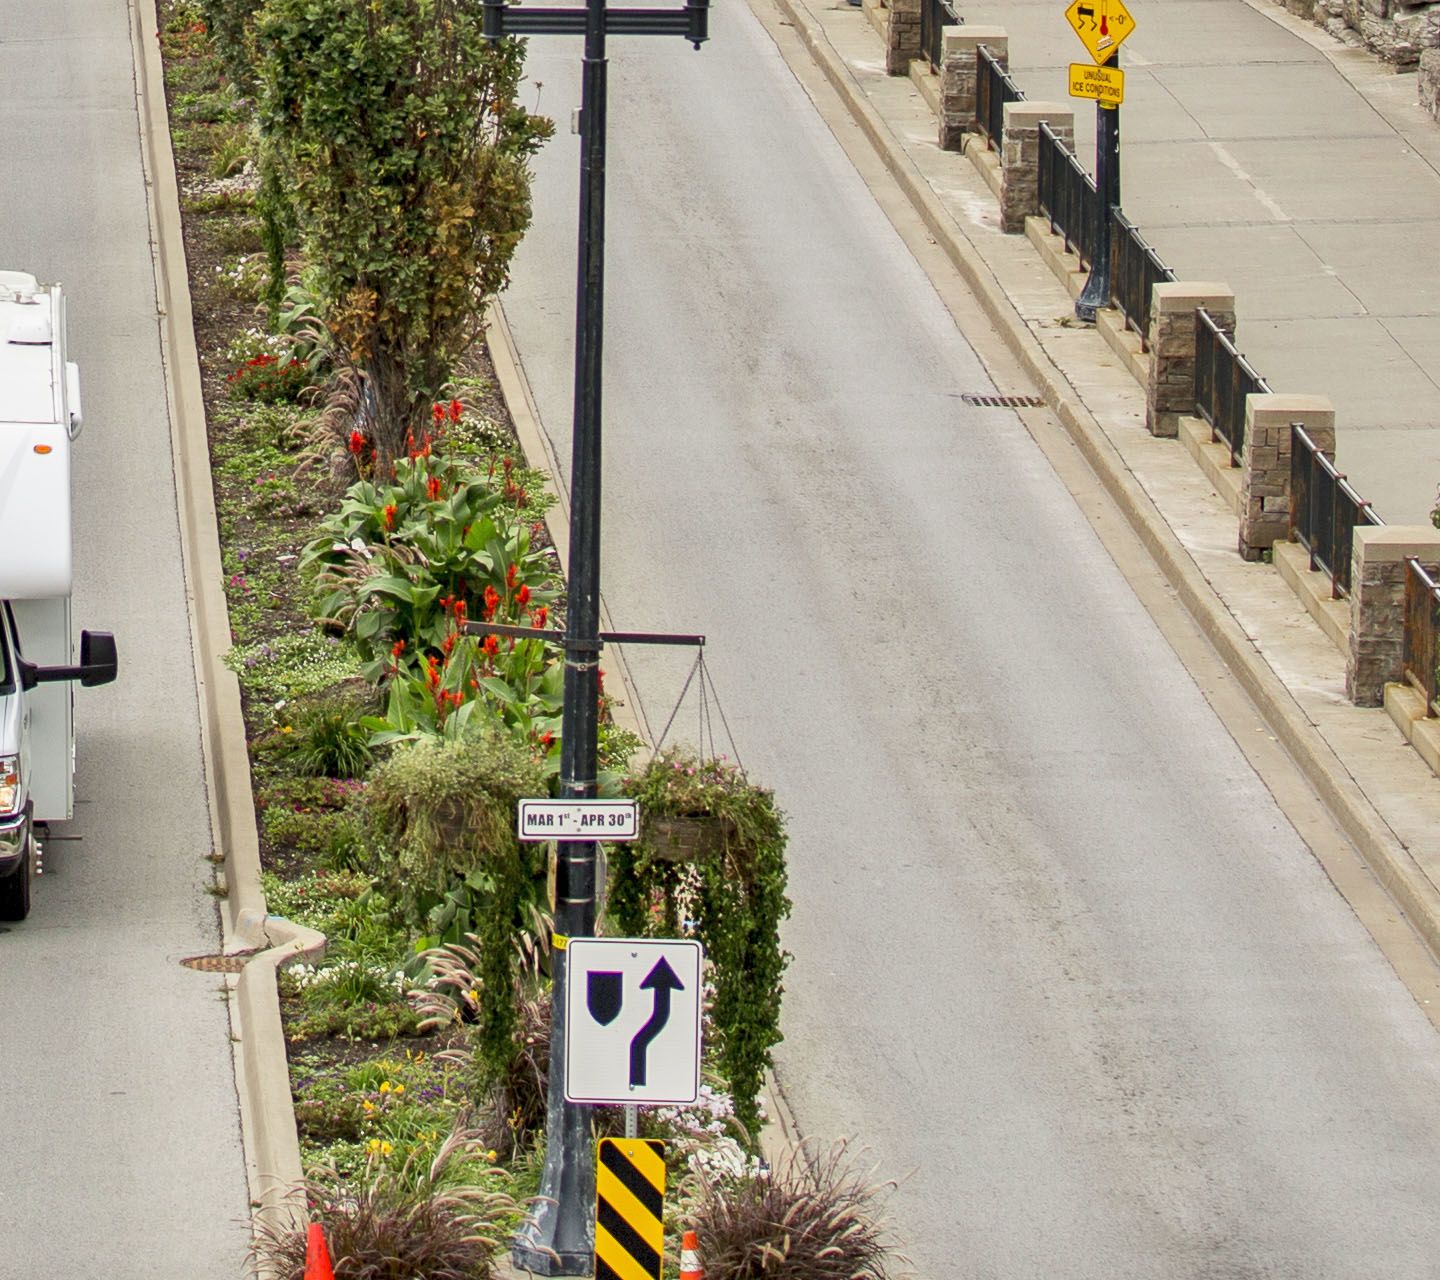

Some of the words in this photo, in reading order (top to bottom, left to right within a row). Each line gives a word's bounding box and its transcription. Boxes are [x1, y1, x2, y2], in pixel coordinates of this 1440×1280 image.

[1083, 70, 1112, 83] UNUSUAL
[1072, 81, 1084, 92] ICE
[1085, 82, 1120, 98] CONDITIONS
[527, 813, 554, 827] MAR
[580, 813, 605, 827] APR
